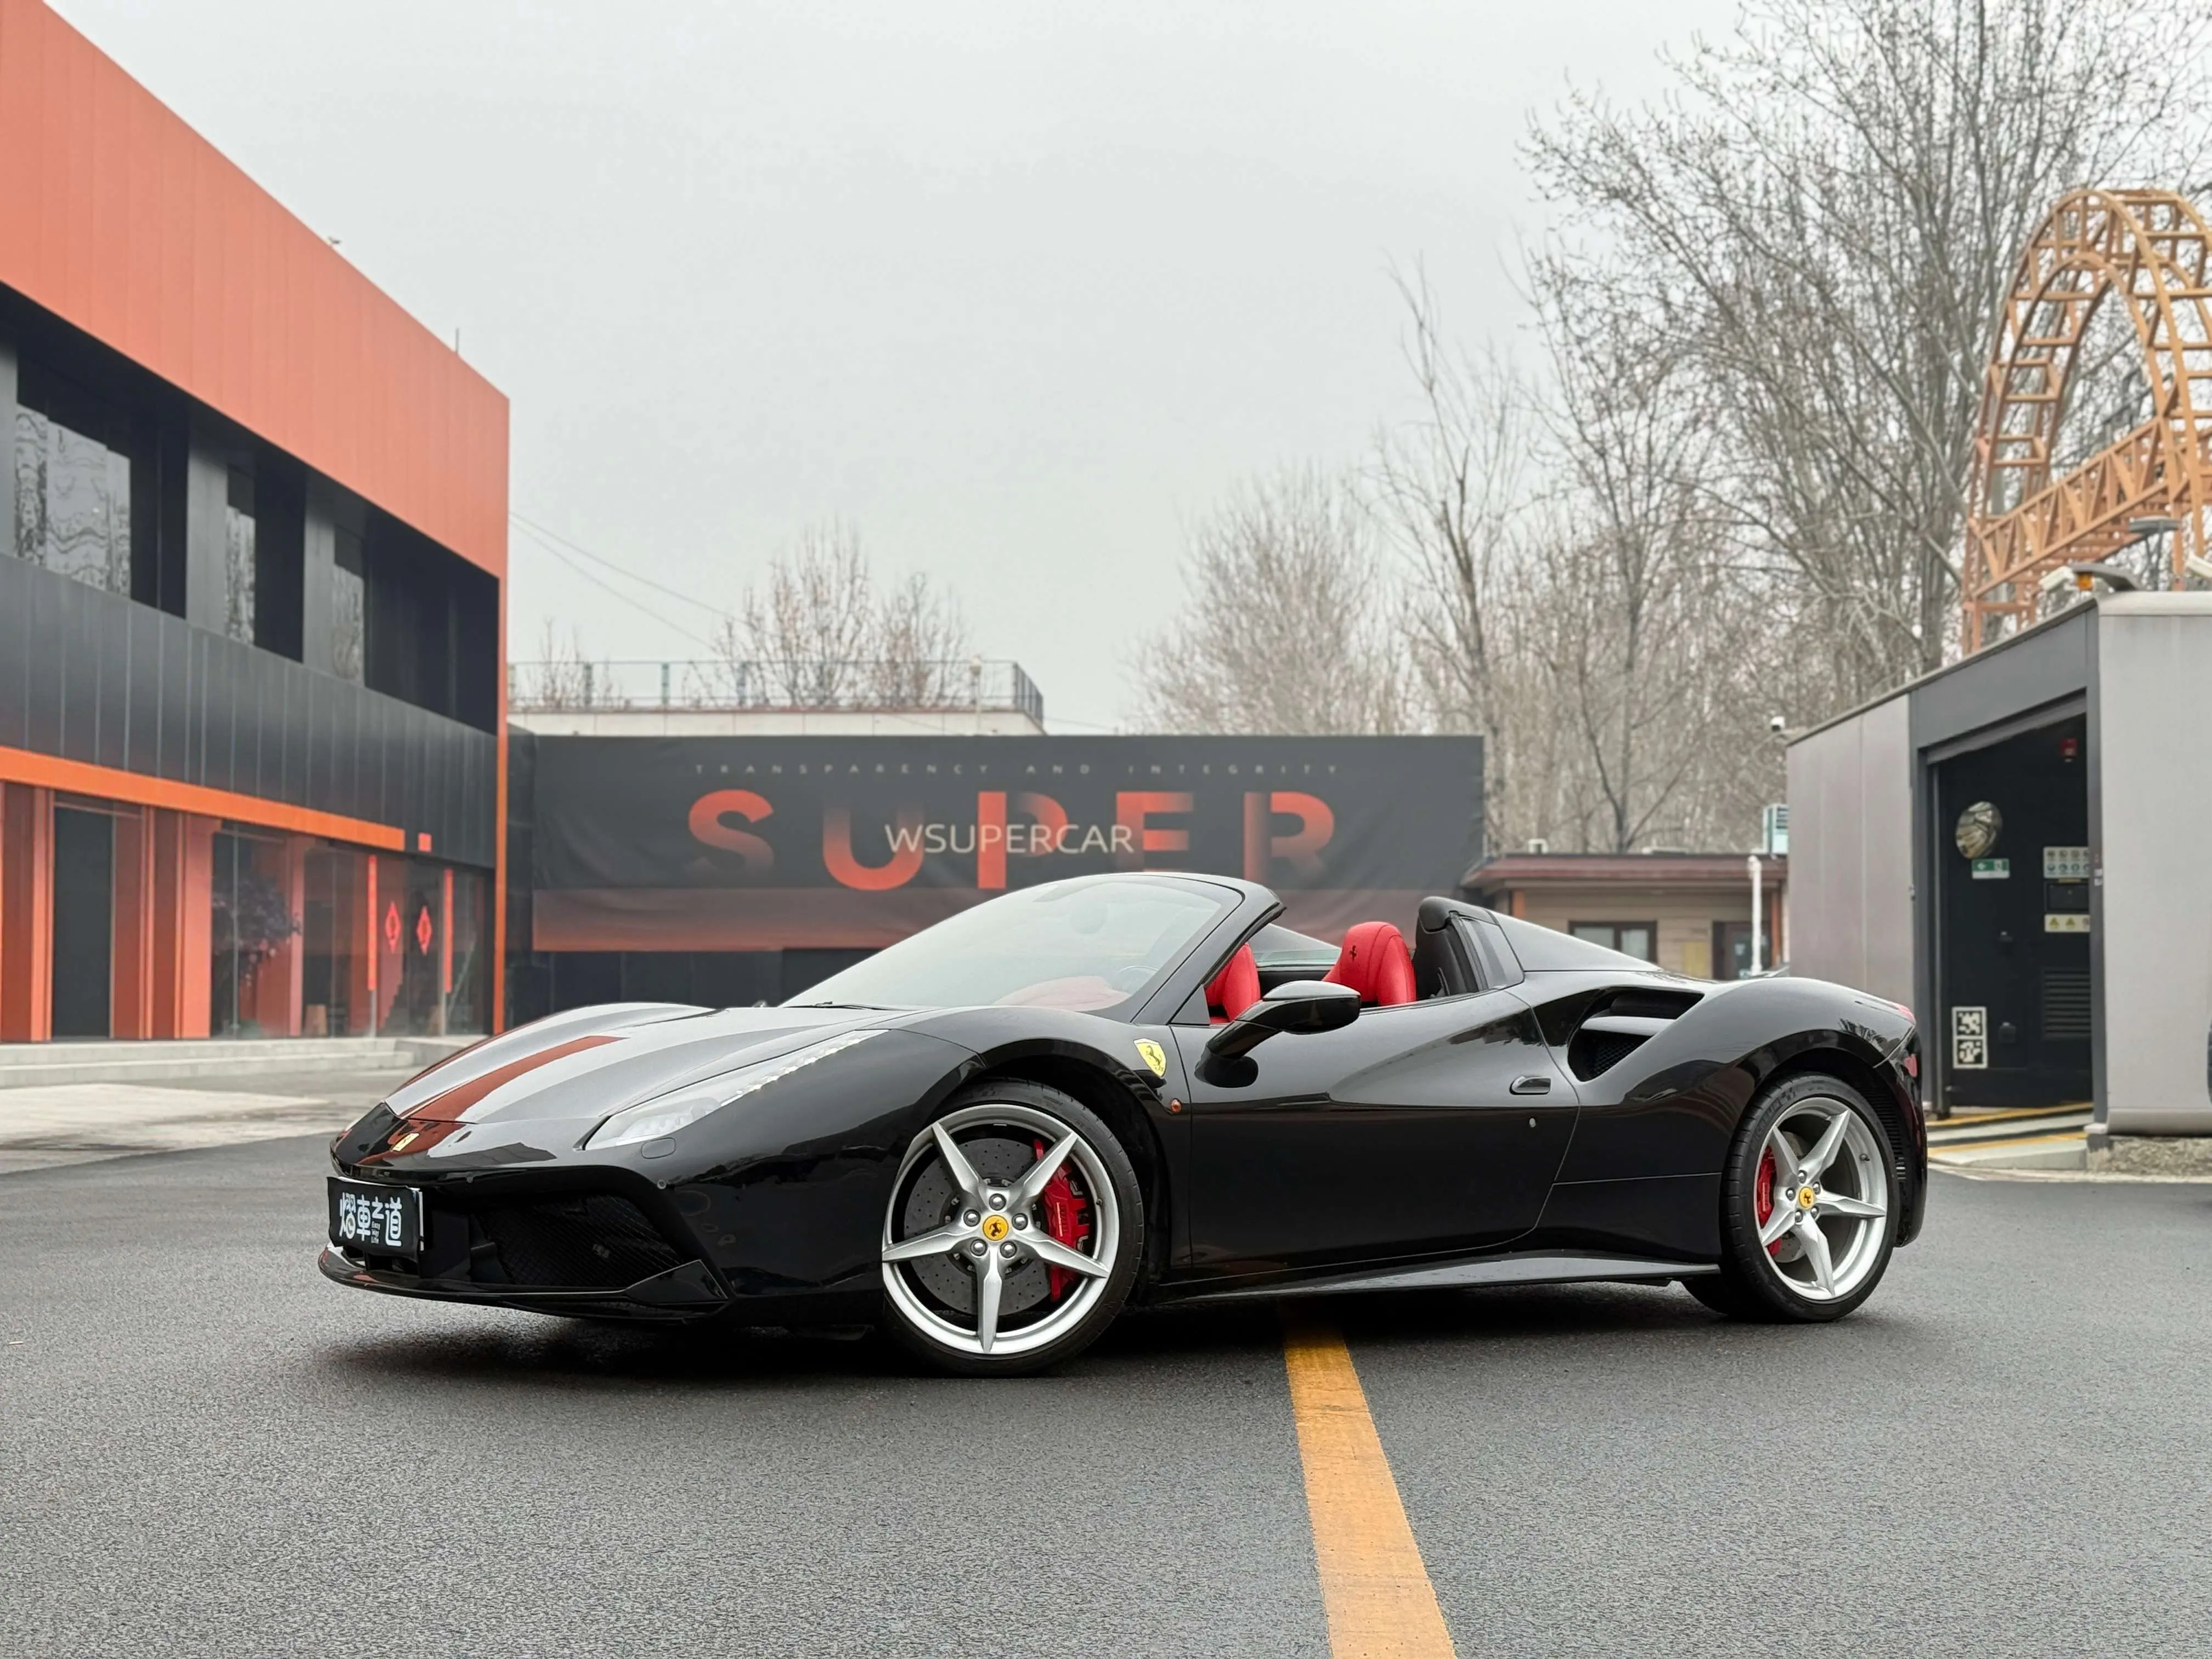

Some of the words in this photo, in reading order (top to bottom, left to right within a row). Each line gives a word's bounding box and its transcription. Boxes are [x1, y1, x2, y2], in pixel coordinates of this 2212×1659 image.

[695, 764, 988, 774] TRANSPARENCY
[1026, 765, 1090, 774] AND
[1128, 765, 1338, 774] INTEGRITY
[687, 788, 1334, 890] SUPER
[884, 824, 1135, 854] WSUPERCAR
